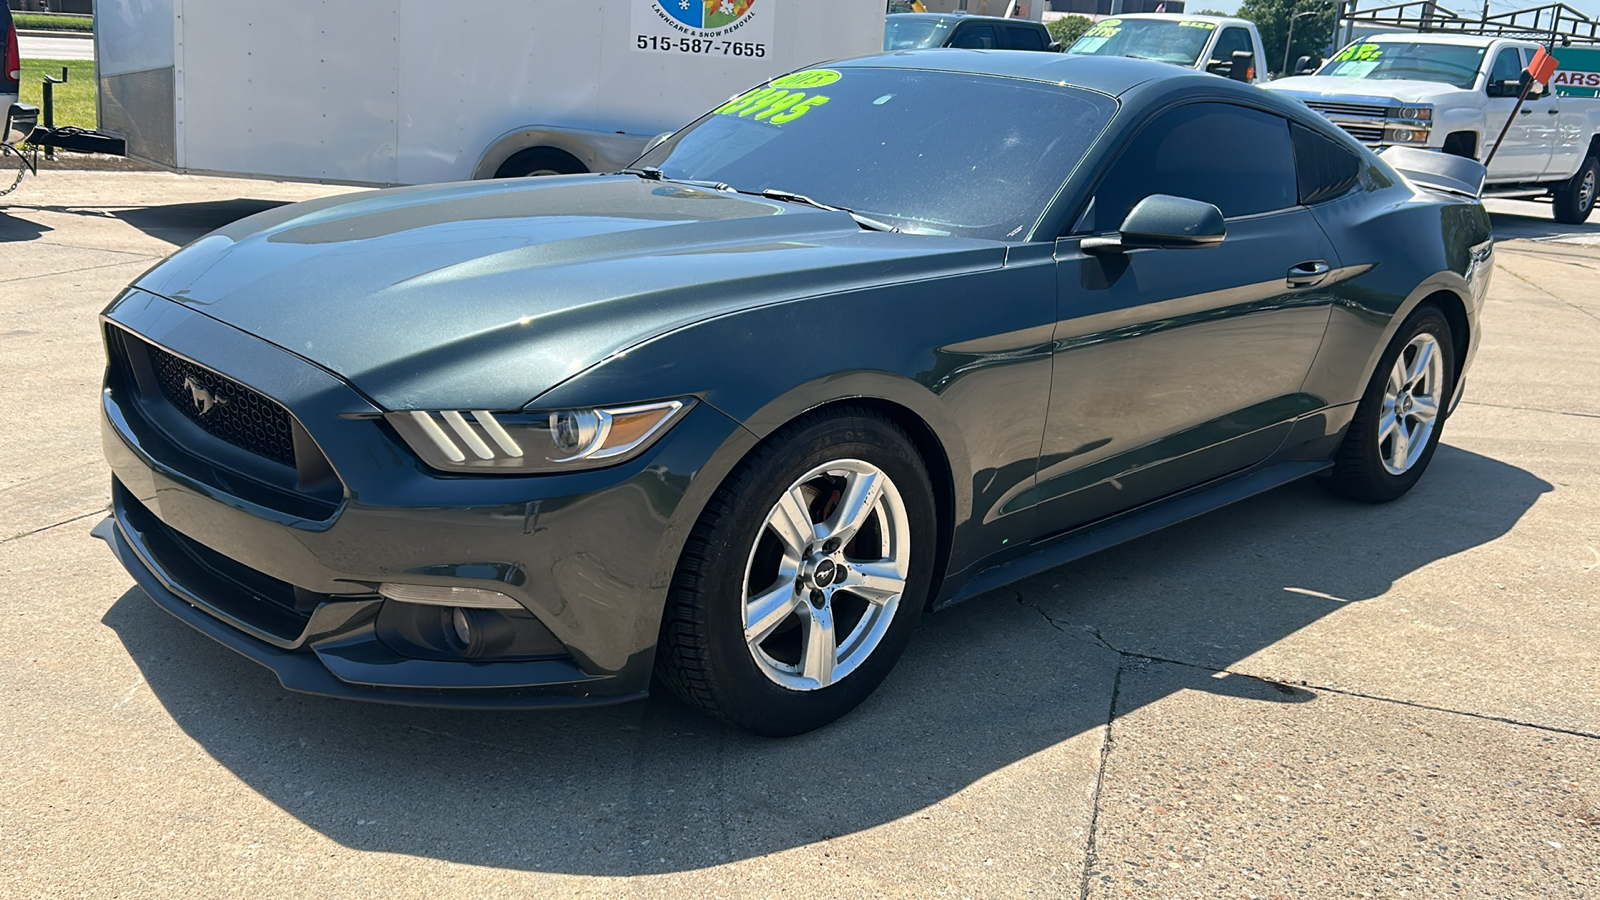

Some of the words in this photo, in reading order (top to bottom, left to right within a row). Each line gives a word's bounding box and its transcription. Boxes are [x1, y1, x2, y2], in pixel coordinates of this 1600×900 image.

[651, 4, 689, 34] LAWNCARE
[724, 11, 756, 35] REMOVAL
[637, 35, 766, 58] 515-587-7655
[1553, 71, 1600, 87] ARS
